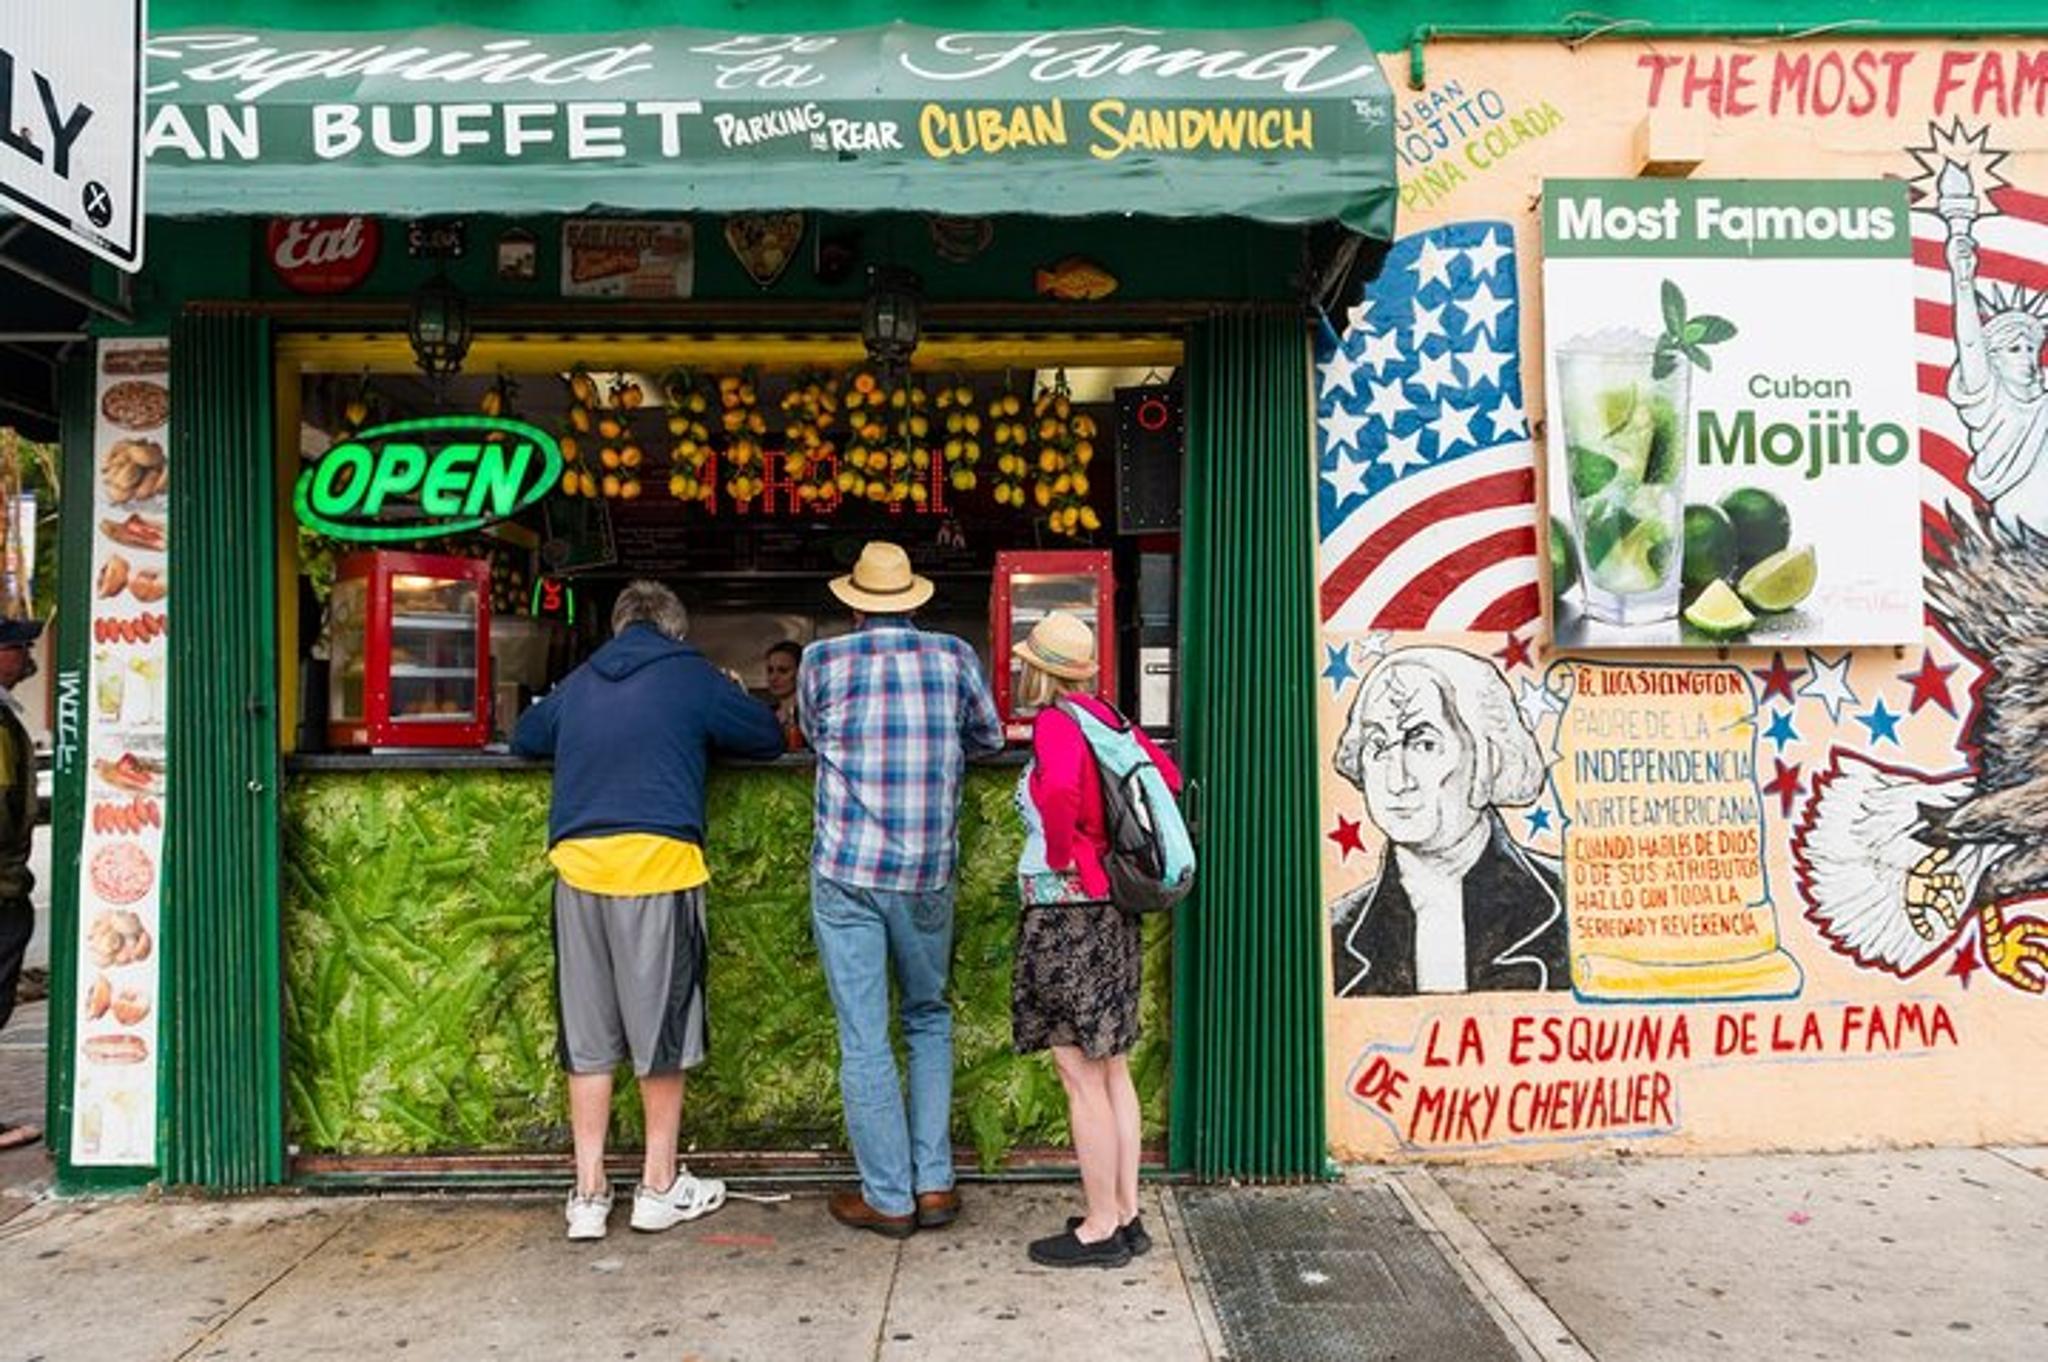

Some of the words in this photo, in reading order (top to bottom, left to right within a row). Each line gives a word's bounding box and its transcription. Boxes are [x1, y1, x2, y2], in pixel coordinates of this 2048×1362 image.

[900, 25, 1375, 93] Fama
[1637, 52, 1758, 118] THE
[1769, 50, 1917, 117] MOST
[1933, 50, 2048, 117] FAM
[145, 104, 260, 160] AN
[313, 101, 703, 159] BUFFET
[713, 102, 826, 148] PARKING
[827, 117, 905, 151] REAR
[919, 98, 1067, 159] CUBAN
[1088, 99, 1314, 160] SANDWICH
[1396, 88, 1505, 166] OJITO
[1465, 101, 1564, 170] COLADA
[275, 217, 364, 268] Eat
[1557, 198, 1682, 241] Most
[1697, 198, 1896, 241] Famous
[1749, 374, 1851, 400] Cuban
[1697, 410, 1911, 478] Mojito
[311, 443, 533, 517] OPEN
[1601, 669, 1744, 696] WASHINGTON
[1574, 707, 1640, 740] PADRE
[1645, 709, 1673, 740] DE
[1680, 711, 1710, 740] LA
[1575, 749, 1752, 784] INDEPENDENCIA
[1575, 835, 1633, 860] CUANDO
[1695, 832, 1714, 856] DE
[1718, 828, 1758, 854] DIOS
[1620, 861, 1657, 885] SUS
[1640, 887, 1668, 909] CON
[1671, 884, 1714, 907] TODA
[1717, 885, 1741, 905] LA
[1661, 909, 1759, 936] REVERENCIA
[1423, 1016, 1485, 1067] LA
[1508, 1015, 1691, 1065] ESQUINA
[1715, 1013, 1758, 1055] DE
[1771, 1011, 1824, 1052] LA
[1840, 1002, 1959, 1051] FAMA
[1353, 1056, 1409, 1113] DE
[1408, 1084, 1502, 1144] MIKY
[1507, 1071, 1674, 1135] CHEVALIER
